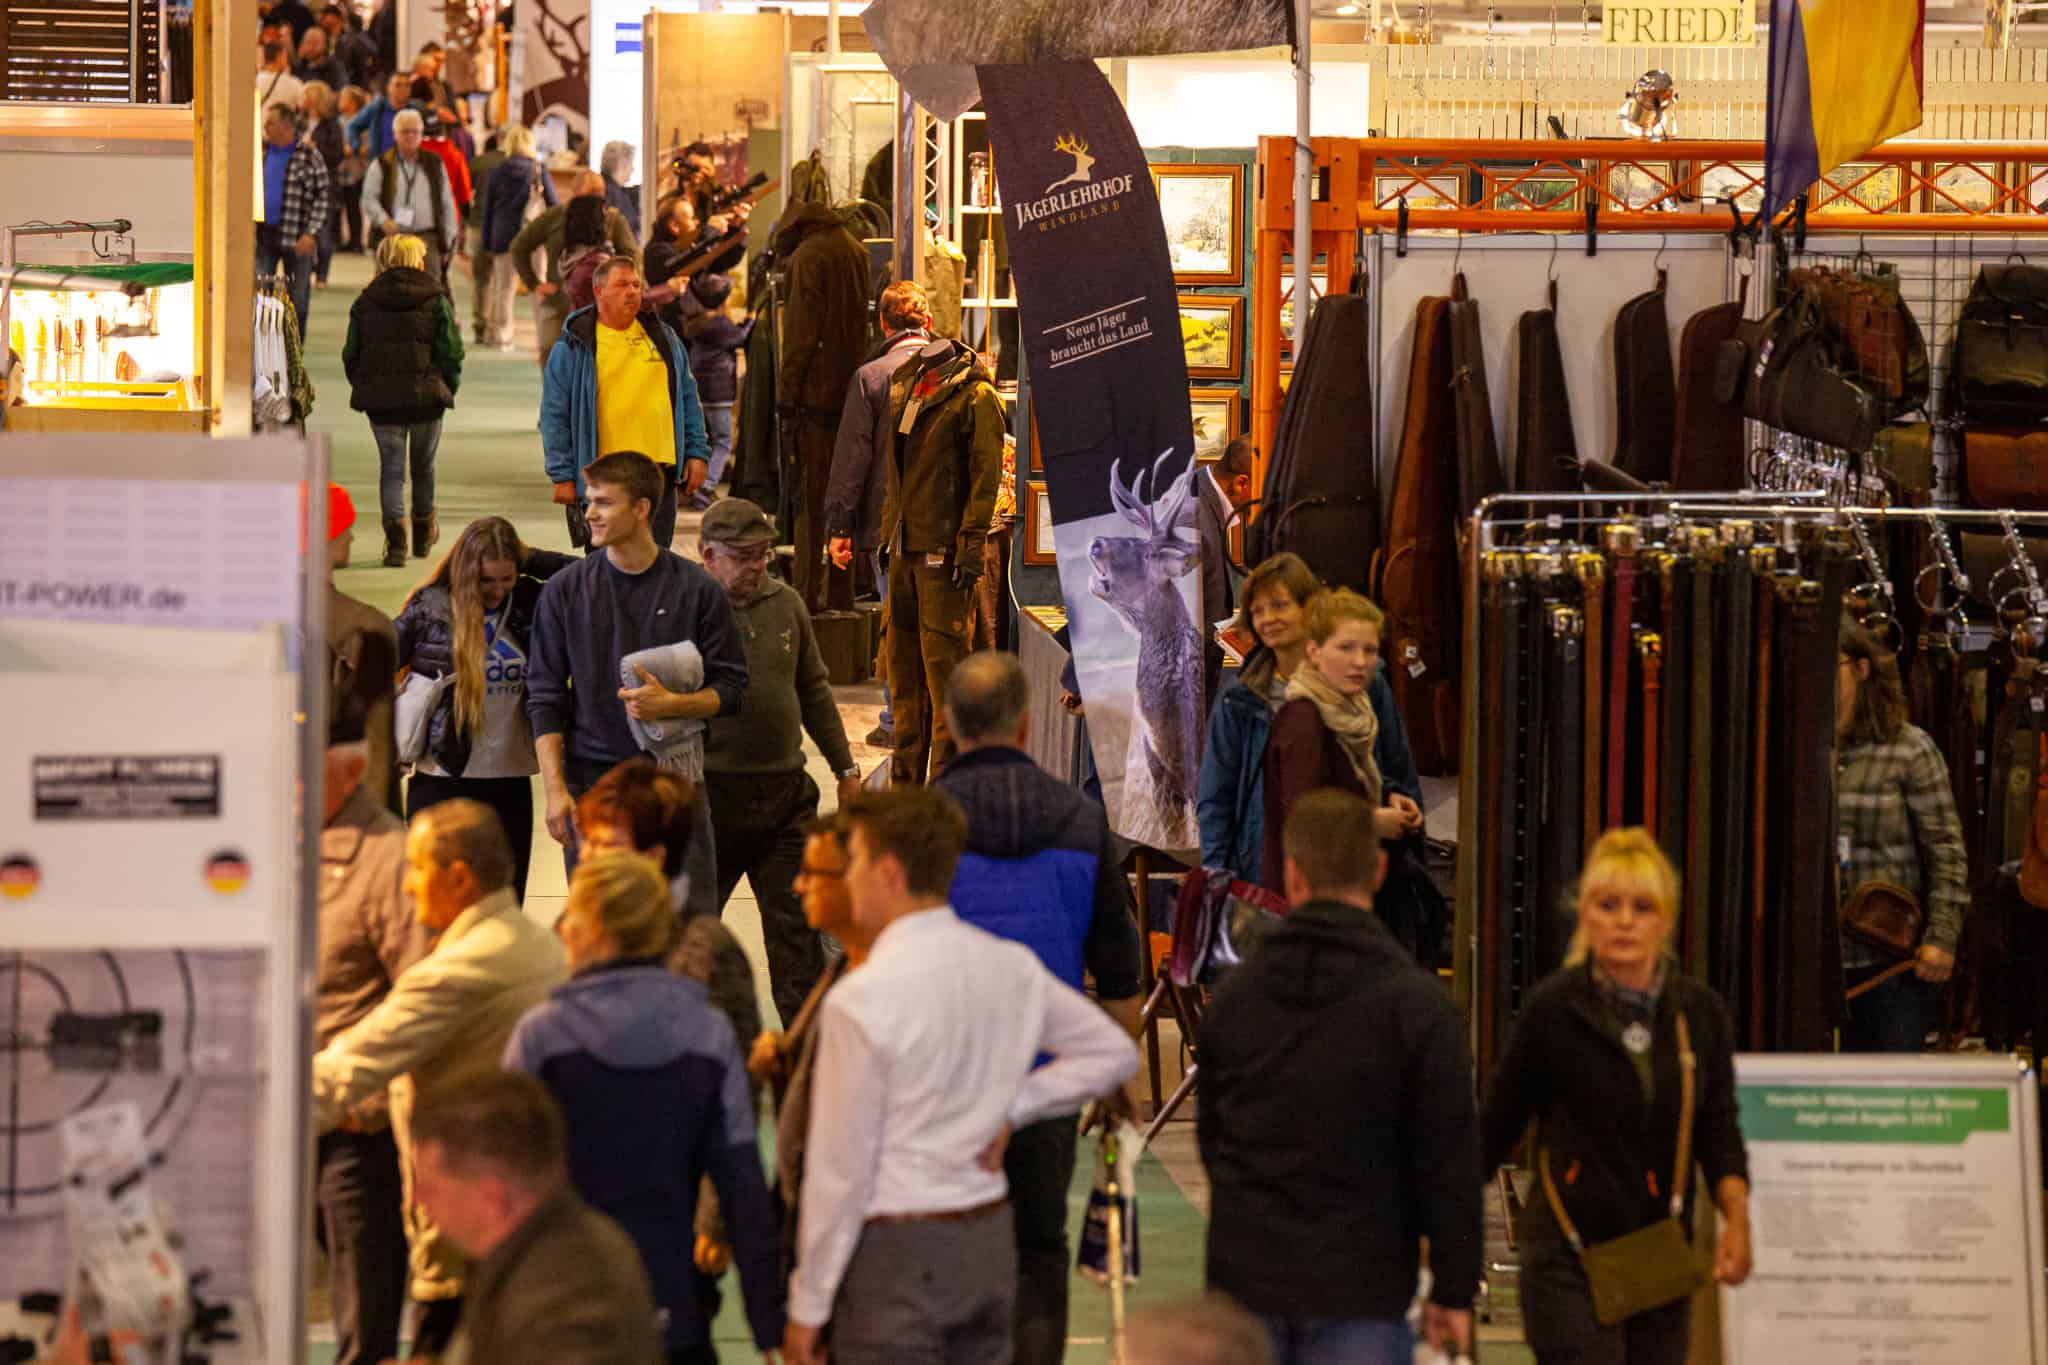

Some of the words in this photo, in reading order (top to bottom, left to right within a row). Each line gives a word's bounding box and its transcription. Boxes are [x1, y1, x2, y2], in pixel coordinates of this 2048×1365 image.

[1606, 7, 1753, 43] FRIEDL
[1015, 174, 1133, 231] JÄGERLEHRHOF
[1050, 336, 1097, 361] braucht
[1098, 331, 1119, 346] das
[1119, 317, 1149, 339] Land
[1066, 321, 1097, 340] Neue
[1097, 311, 1127, 331] Jäger
[0, 581, 187, 612] T-POWER.de
